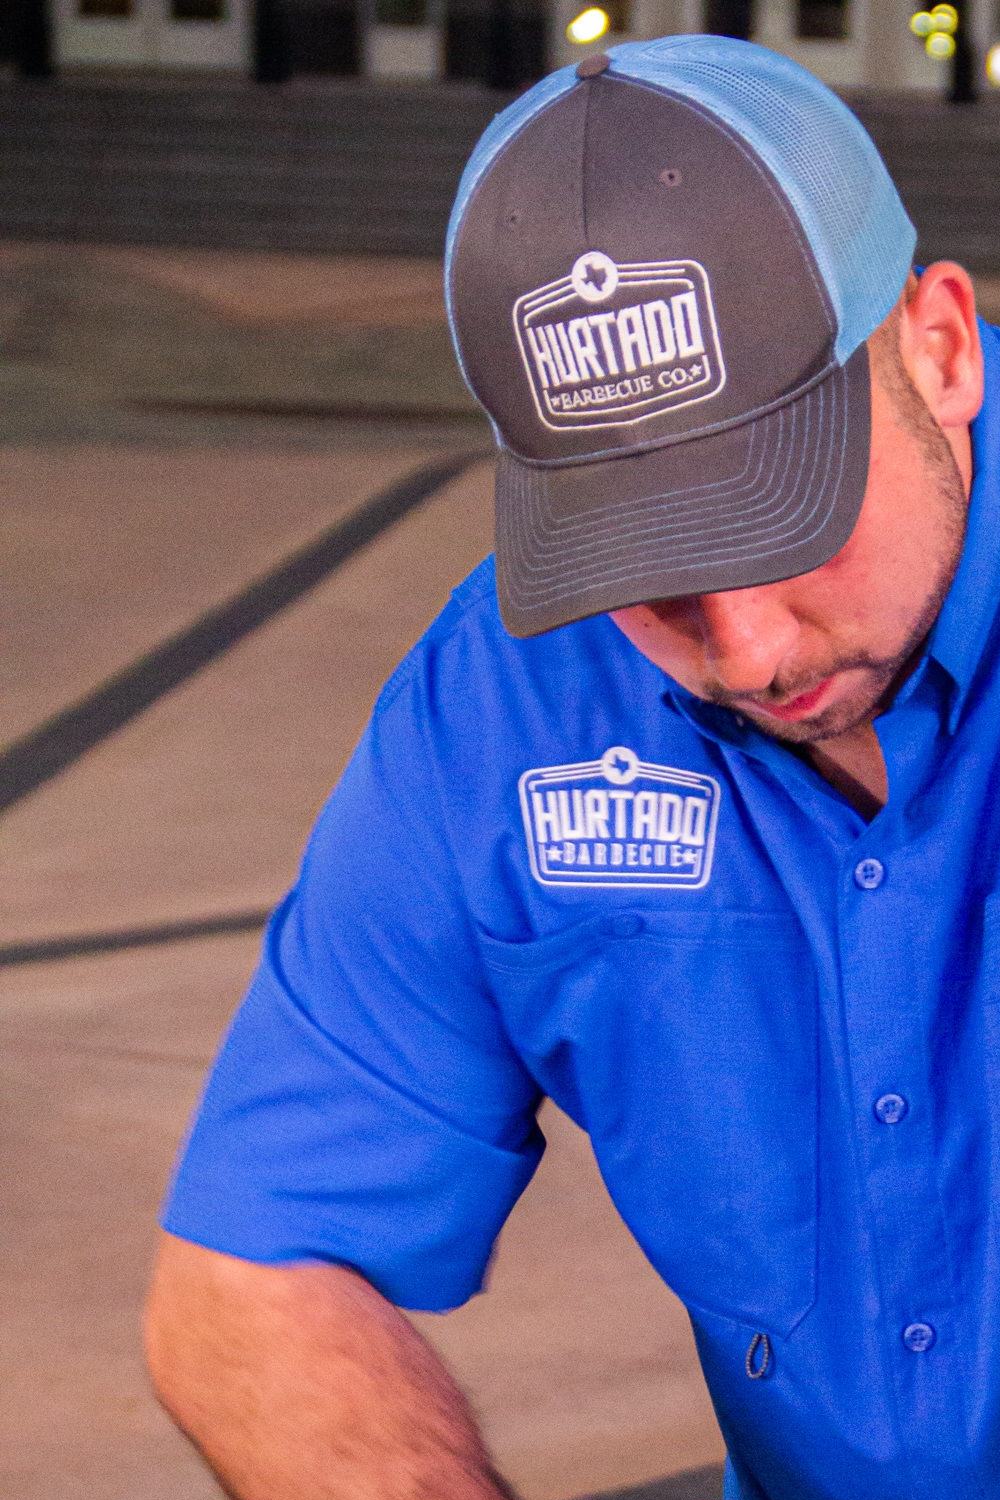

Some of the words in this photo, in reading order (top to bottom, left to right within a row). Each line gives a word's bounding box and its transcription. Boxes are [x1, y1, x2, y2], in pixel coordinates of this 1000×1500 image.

[527, 291, 704, 388] HURTADO
[562, 375, 654, 410] BARBECUE
[658, 367, 694, 387] CO.
[531, 789, 708, 846] HURTADO
[563, 842, 683, 867] BARBECUE
